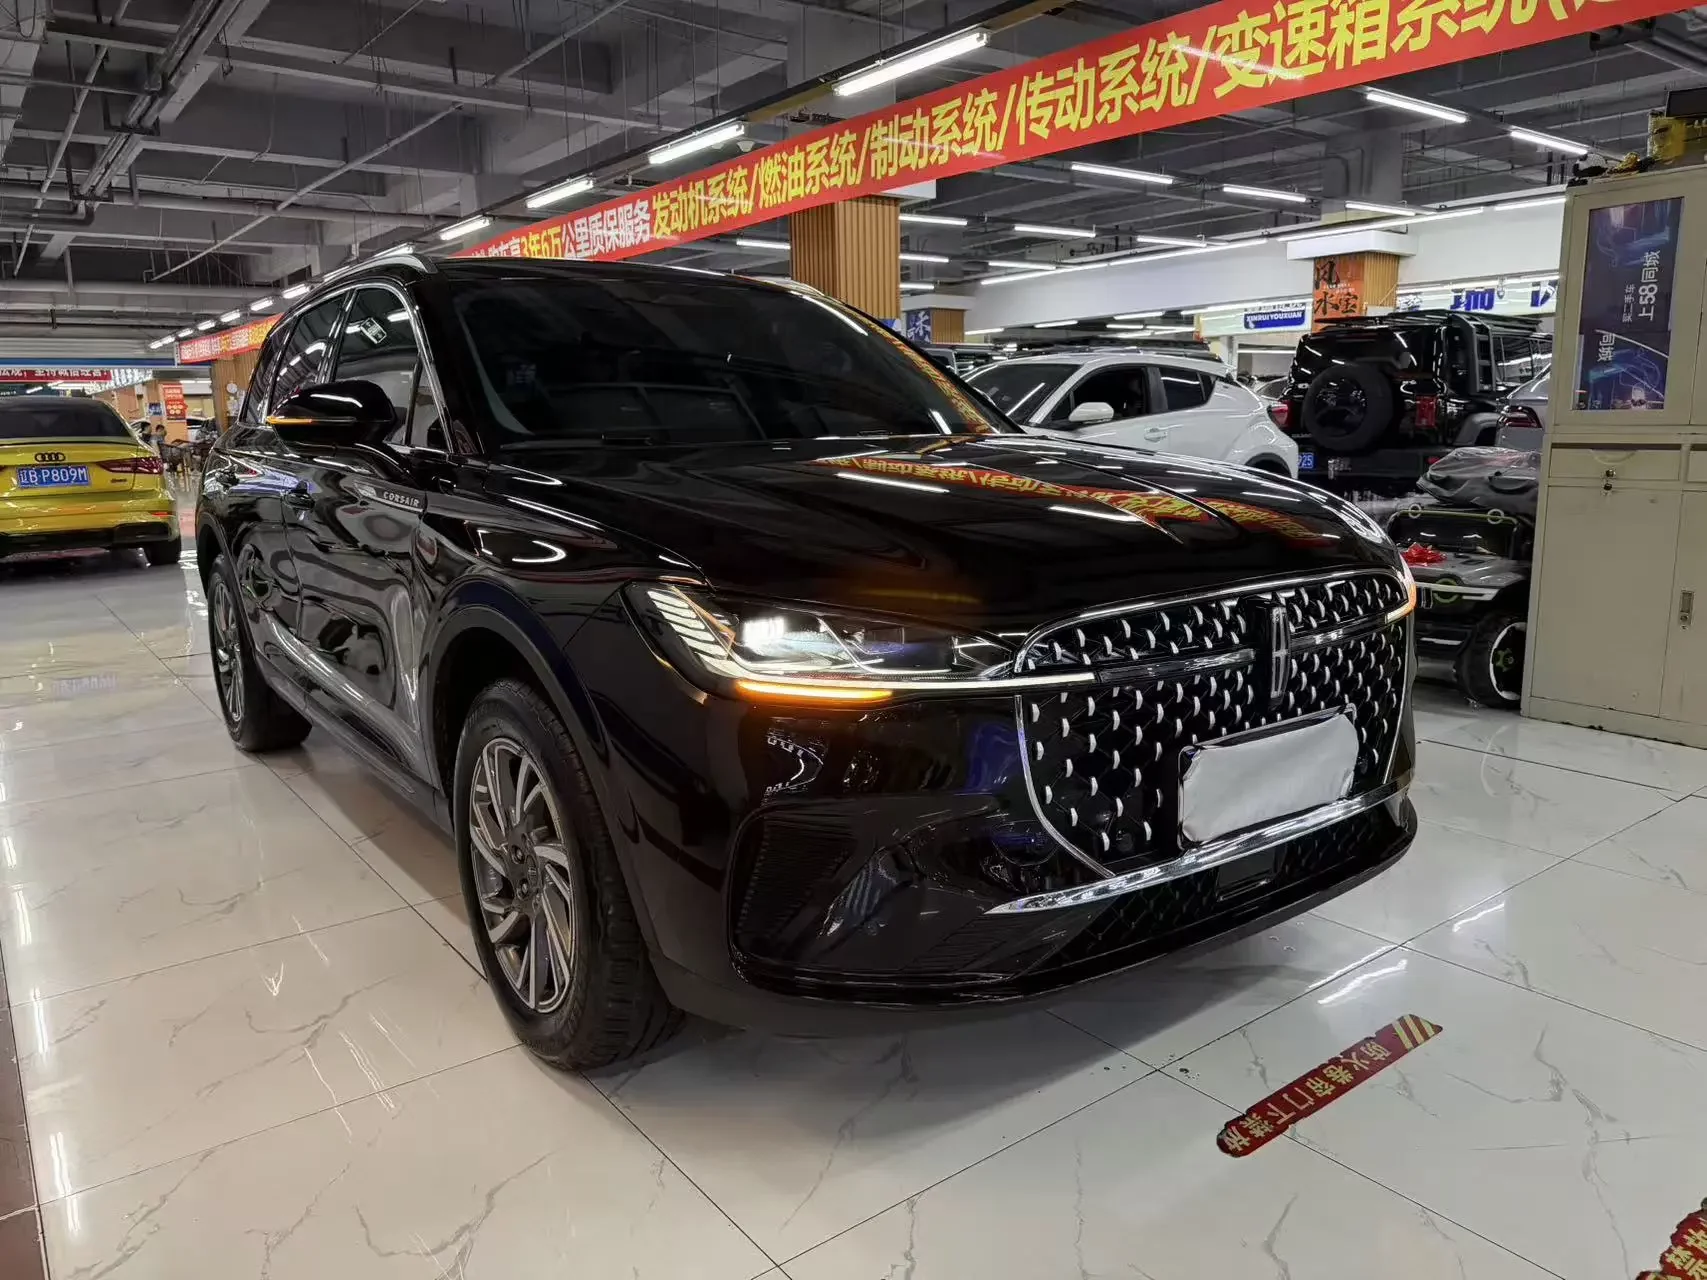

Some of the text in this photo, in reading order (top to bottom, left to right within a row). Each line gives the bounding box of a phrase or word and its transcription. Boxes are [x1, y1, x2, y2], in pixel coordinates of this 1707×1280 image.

[1638, 249, 1661, 321] 上58同城
[383, 491, 420, 508] CORSAIR
